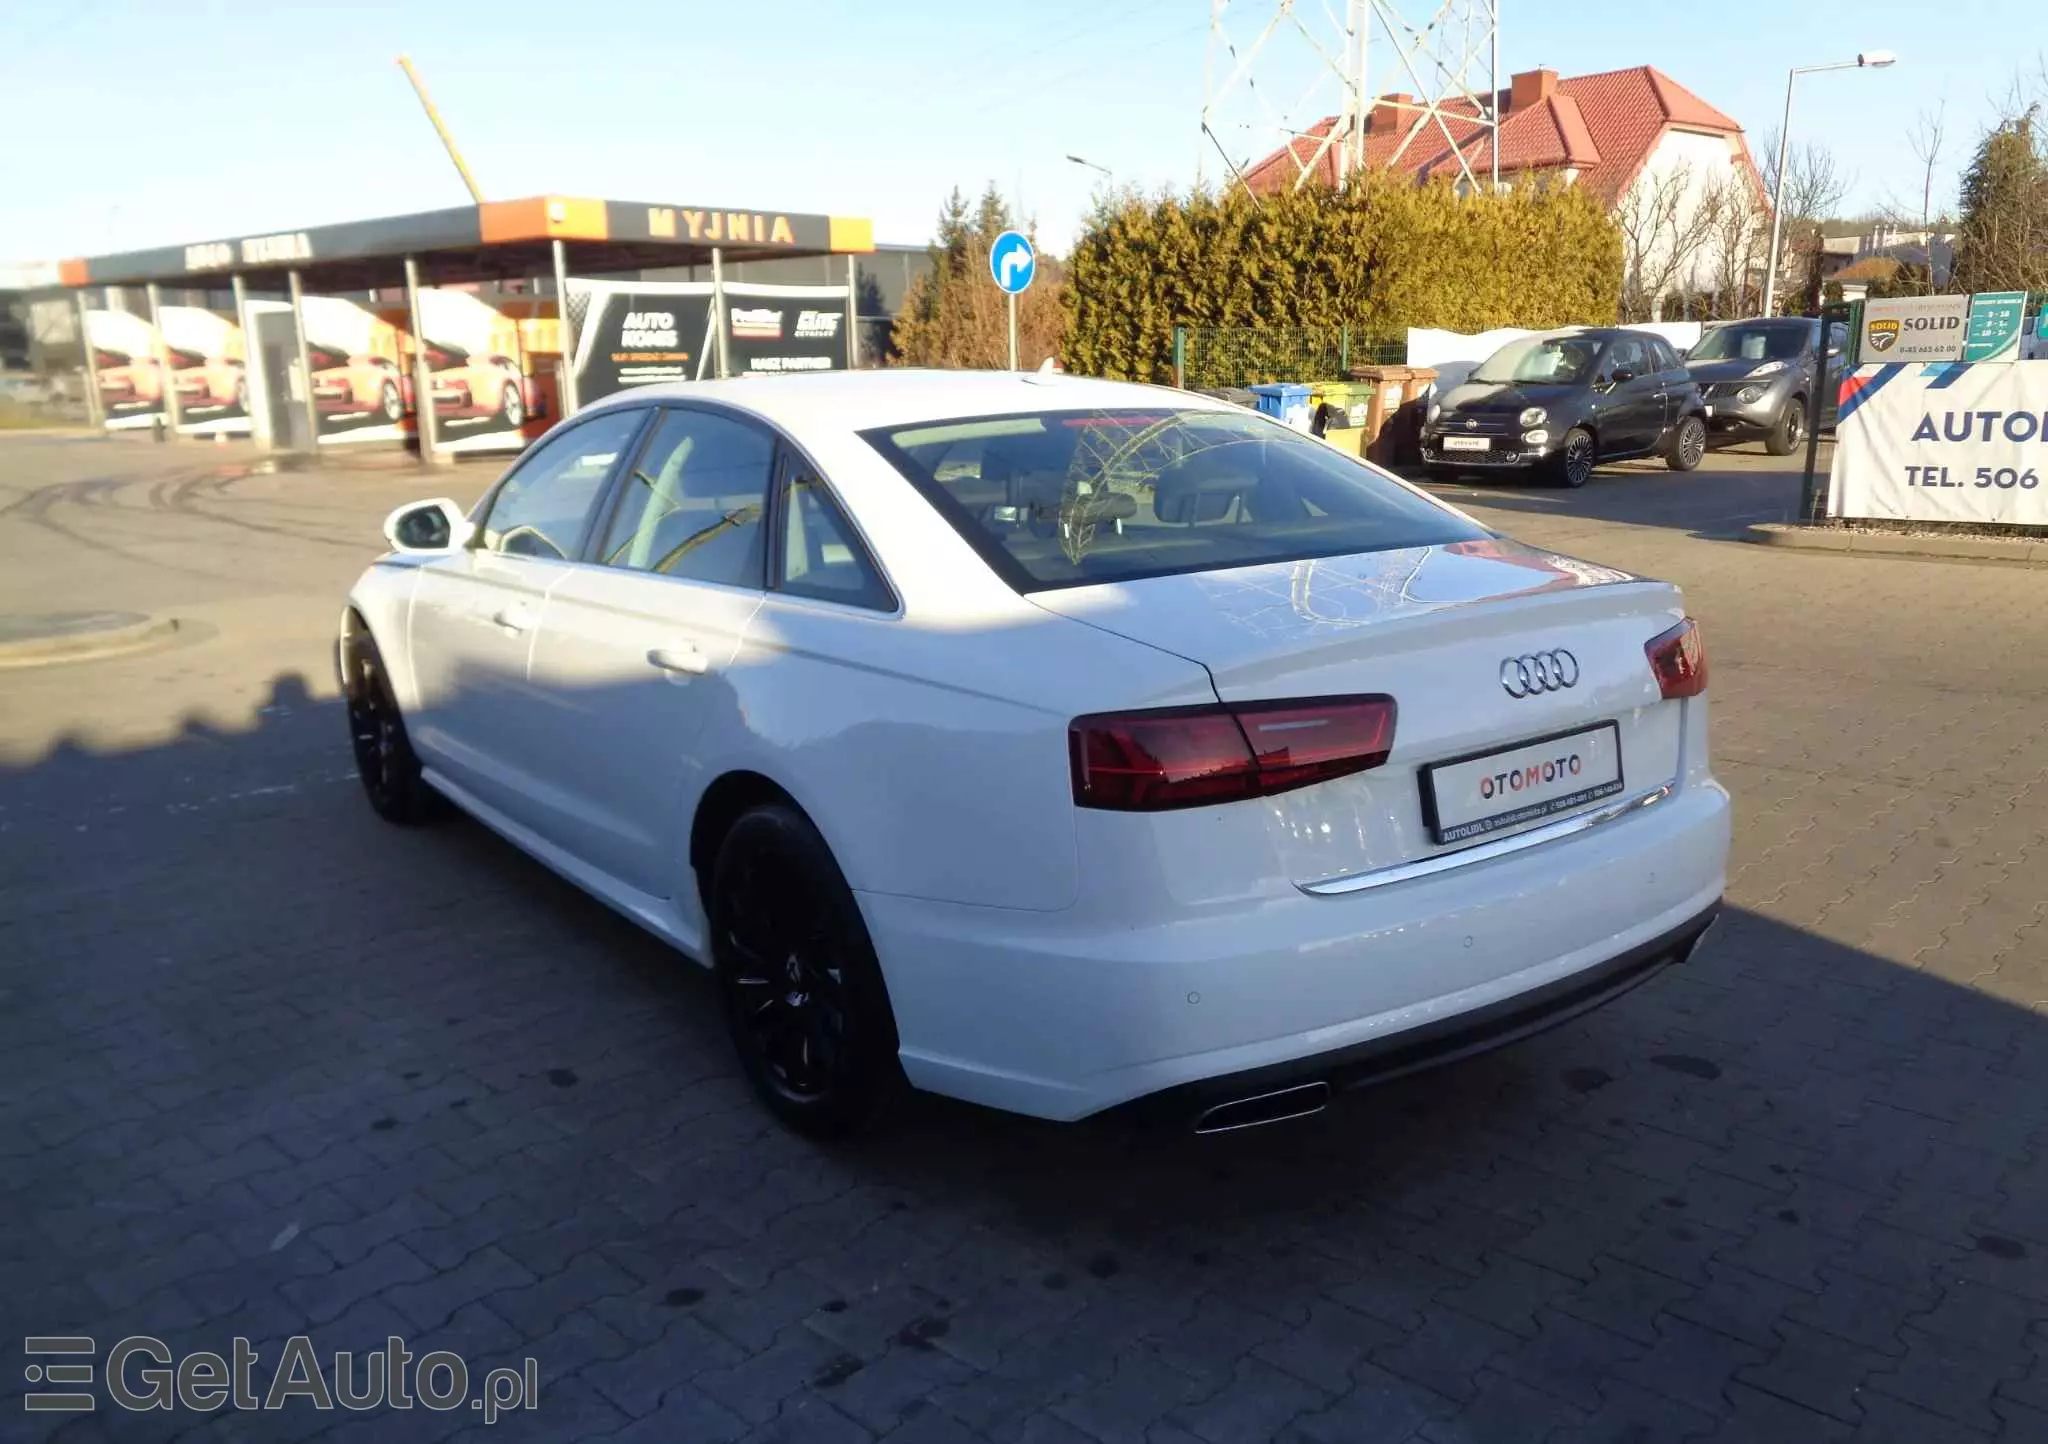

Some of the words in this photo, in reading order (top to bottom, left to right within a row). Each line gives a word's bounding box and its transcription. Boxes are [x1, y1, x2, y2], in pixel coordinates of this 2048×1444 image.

[648, 207, 795, 244] MYJNIA
[1904, 316, 1960, 331] SOLID
[1904, 466, 1965, 488] TEL.
[1974, 467, 2040, 489] 506
[1481, 754, 1581, 799] OTOMOTO
